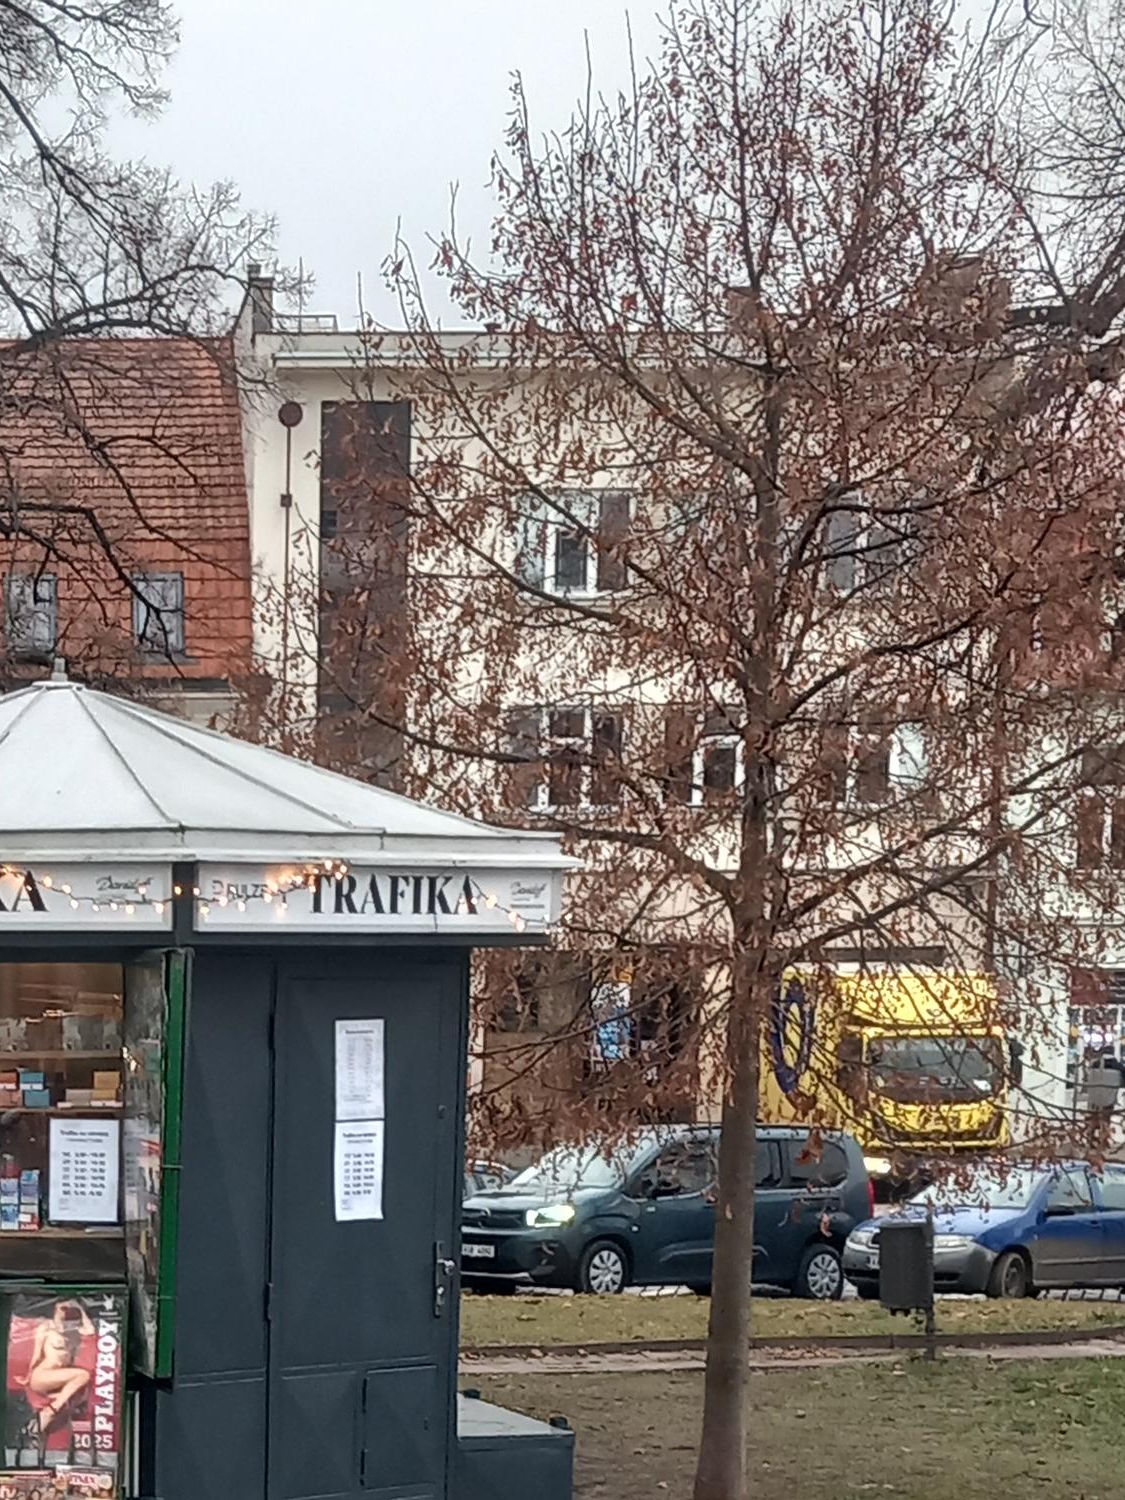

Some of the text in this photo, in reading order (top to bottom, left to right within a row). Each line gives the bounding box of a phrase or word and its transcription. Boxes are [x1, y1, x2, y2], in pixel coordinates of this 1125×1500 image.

[311, 873, 478, 915] TRAFIKA
[94, 1318, 118, 1432] PLAYBOY
[74, 1433, 113, 1449] 2025
